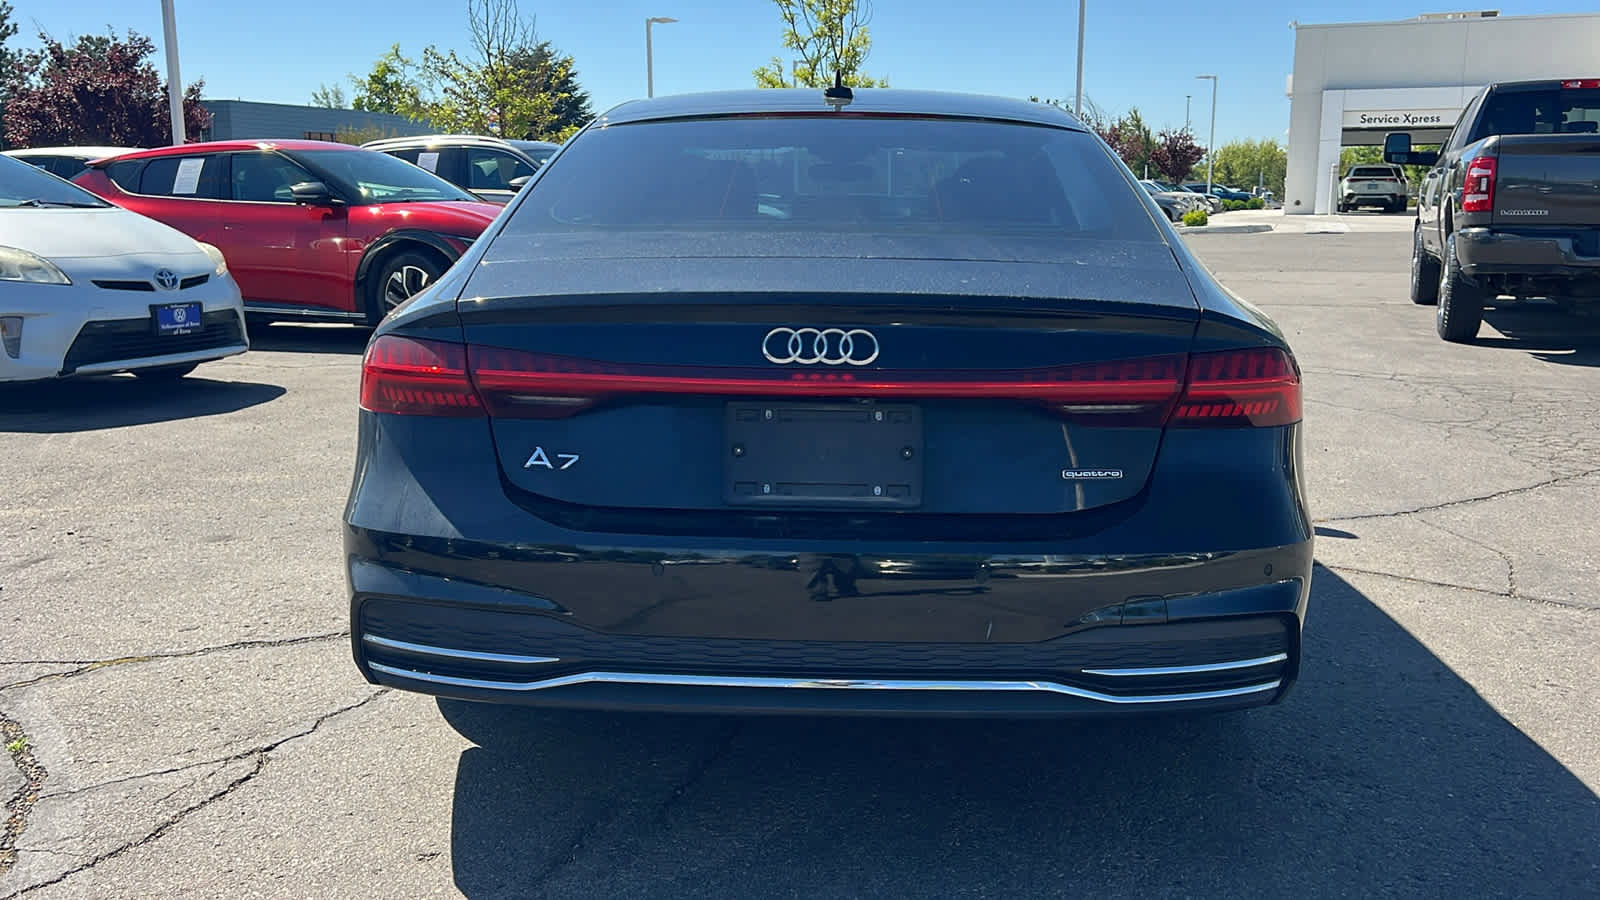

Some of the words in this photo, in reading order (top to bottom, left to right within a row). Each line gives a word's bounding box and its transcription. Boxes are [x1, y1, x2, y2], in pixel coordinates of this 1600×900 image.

[1360, 114, 1400, 124] Service
[1402, 113, 1441, 125] Xpress
[523, 446, 580, 469] A7
[1064, 470, 1121, 479] quattro
